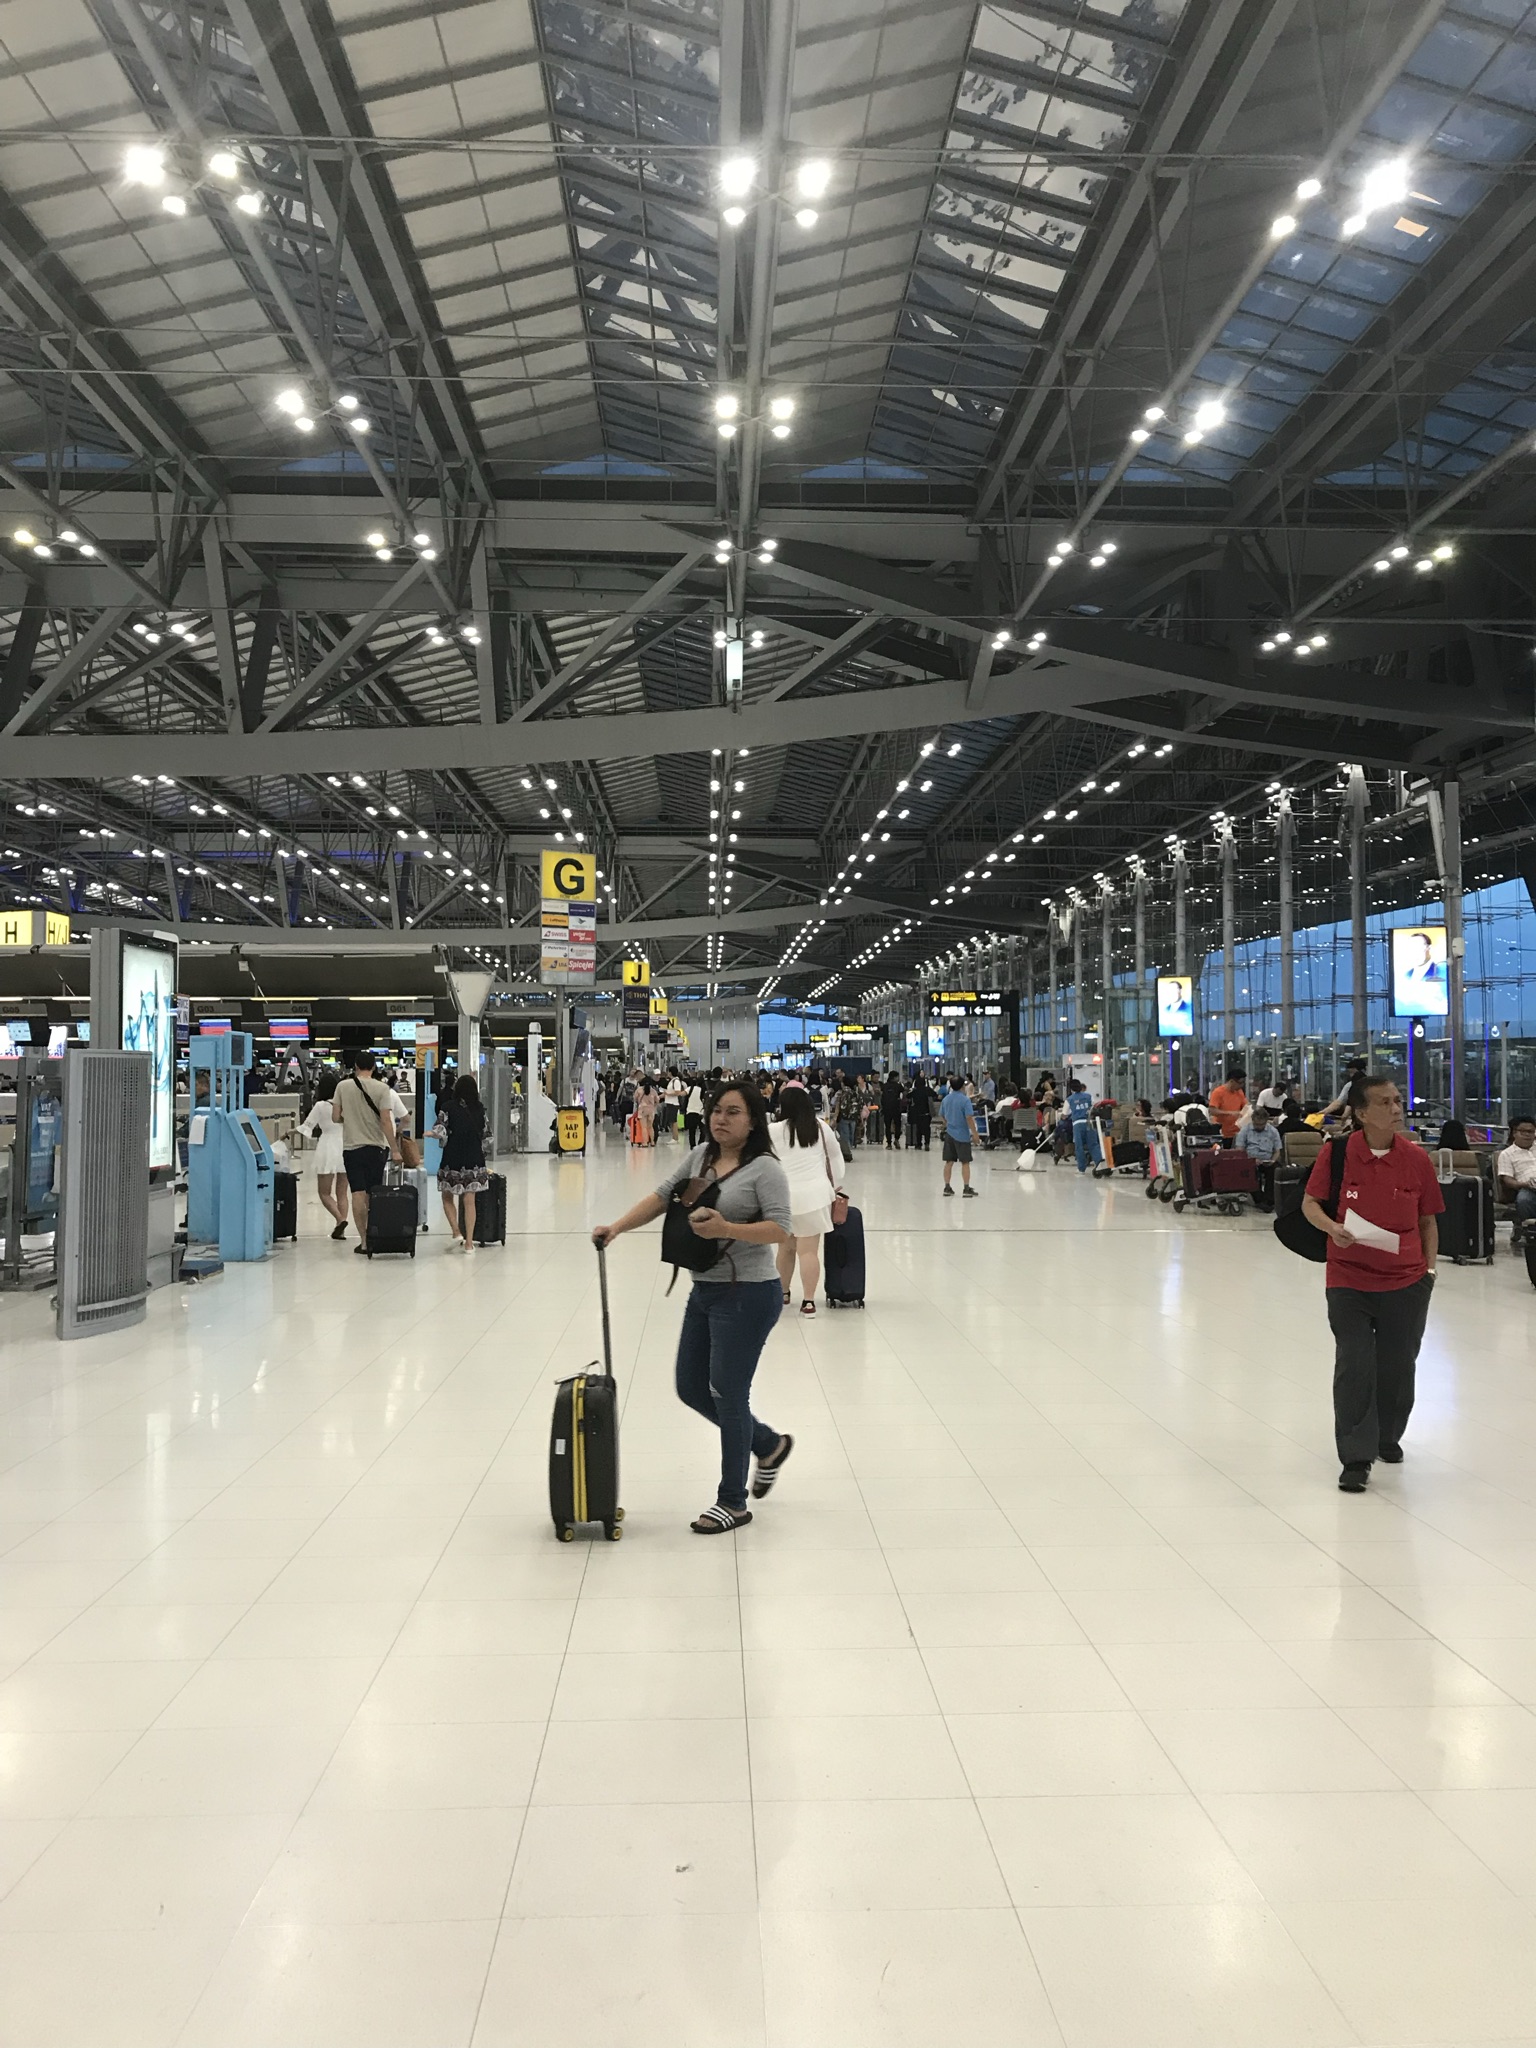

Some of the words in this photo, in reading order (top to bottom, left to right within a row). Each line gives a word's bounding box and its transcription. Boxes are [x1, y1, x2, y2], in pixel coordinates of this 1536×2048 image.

[553, 858, 585, 895] G
[5, 921, 18, 944] H
[47, 921, 68, 945] H/J
[568, 960, 594, 970] SpiceJet
[631, 964, 642, 983] J
[197, 1005, 215, 1013] G03
[291, 1005, 309, 1013] G02
[389, 1005, 407, 1013] G01
[654, 1001, 663, 1013] L
[667, 1017, 675, 1028] N
